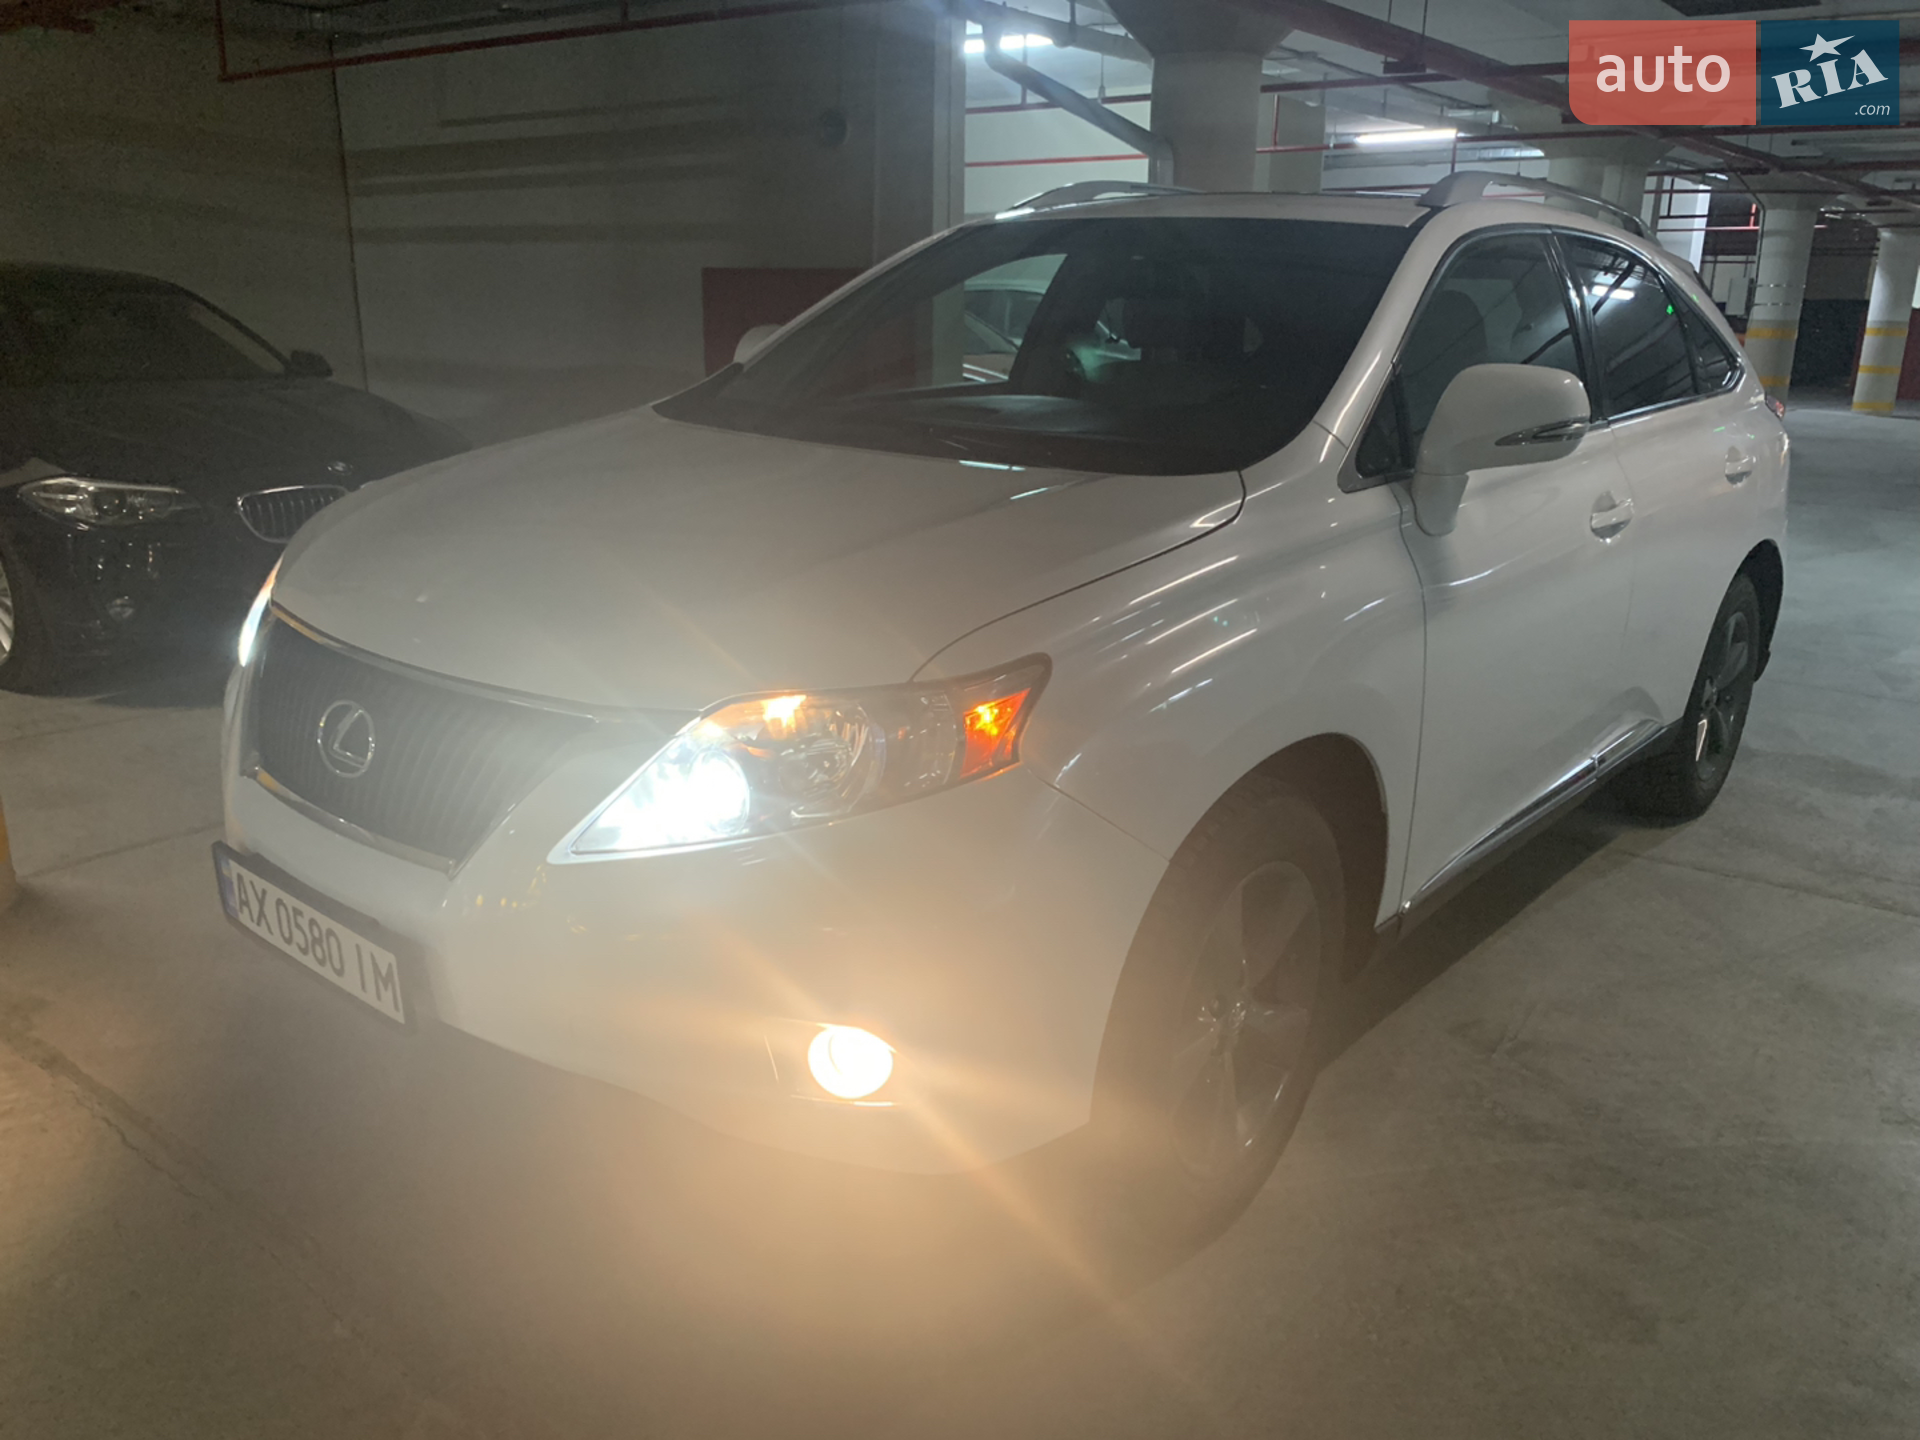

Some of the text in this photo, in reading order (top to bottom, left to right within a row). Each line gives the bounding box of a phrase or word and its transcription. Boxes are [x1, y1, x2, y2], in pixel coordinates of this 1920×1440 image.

[237, 872, 400, 1013] AX 0580 IM
